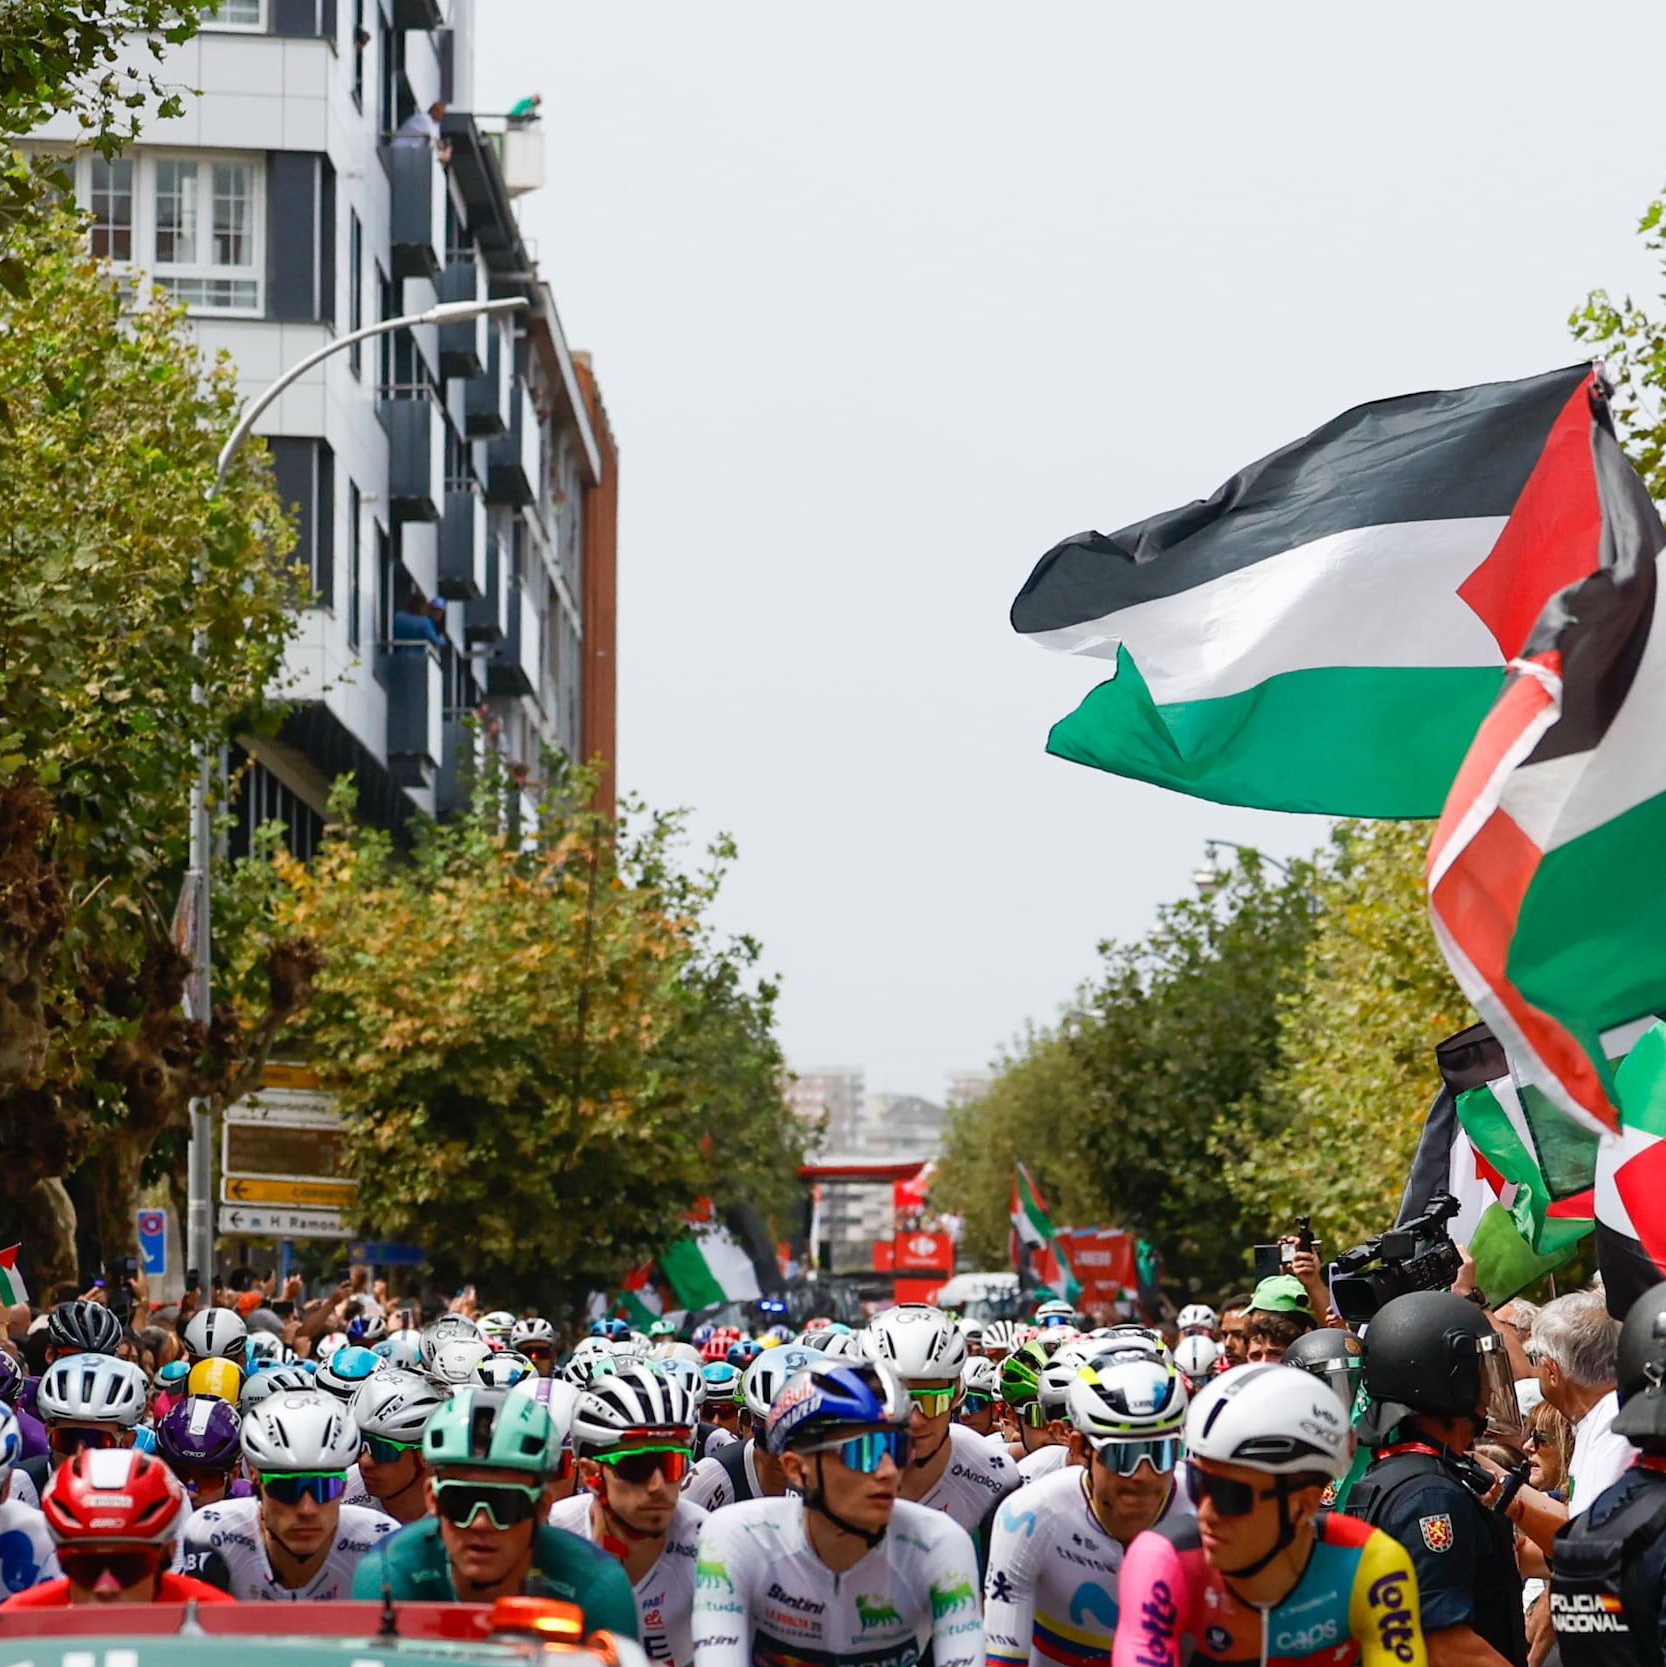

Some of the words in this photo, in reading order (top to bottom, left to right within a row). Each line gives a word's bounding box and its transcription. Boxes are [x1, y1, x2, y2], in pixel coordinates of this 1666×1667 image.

[378, 1395, 406, 1422] MET
[586, 1397, 618, 1418] MET
[962, 1468, 1003, 1493] Analog
[1550, 1593, 1606, 1612] POLICIA
[1276, 1618, 1338, 1650] caps
[1551, 1613, 1630, 1632] NACIONAL
